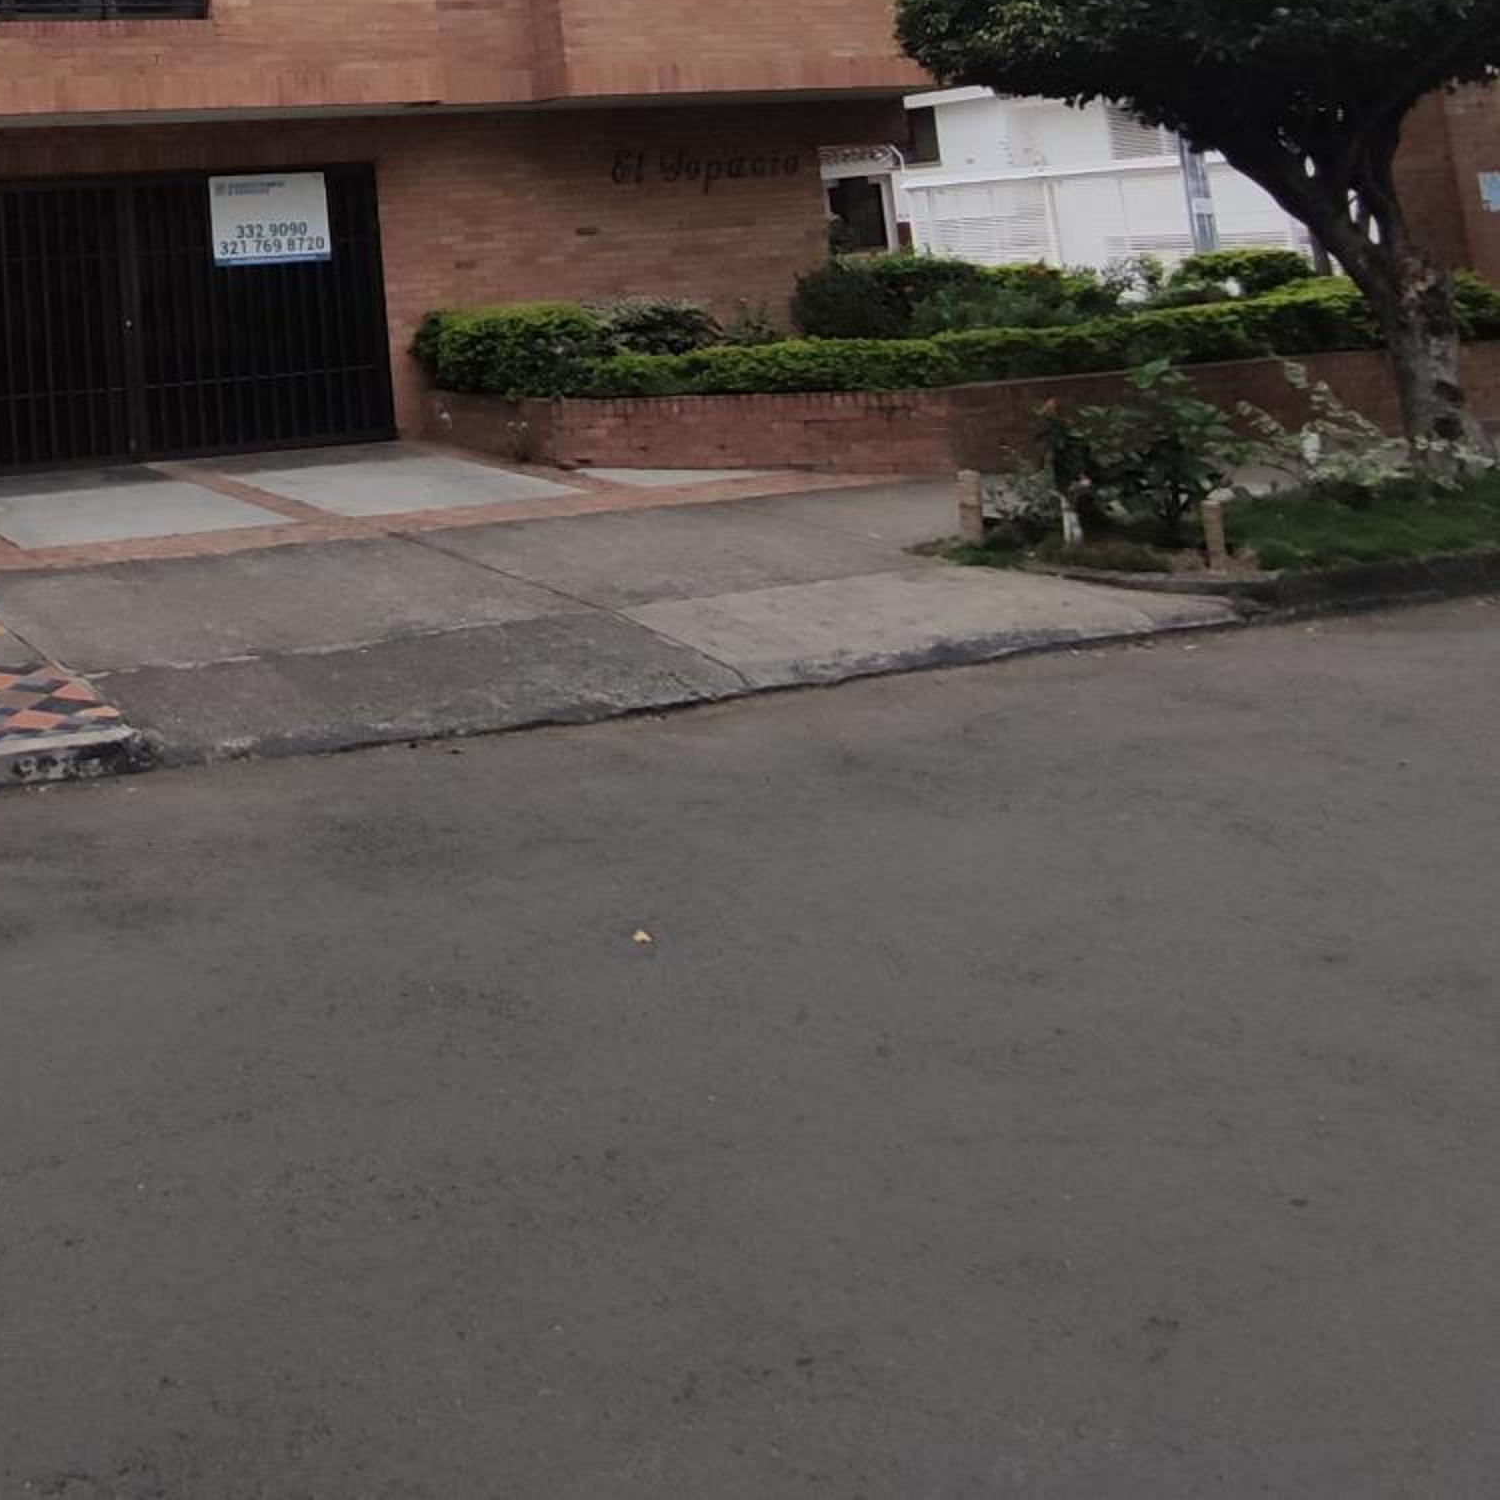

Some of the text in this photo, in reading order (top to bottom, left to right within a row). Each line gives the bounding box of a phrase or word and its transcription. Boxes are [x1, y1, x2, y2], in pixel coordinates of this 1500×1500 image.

[611, 148, 644, 184] El
[236, 221, 307, 239] 332 9090
[220, 236, 325, 256] 321 769 8720
